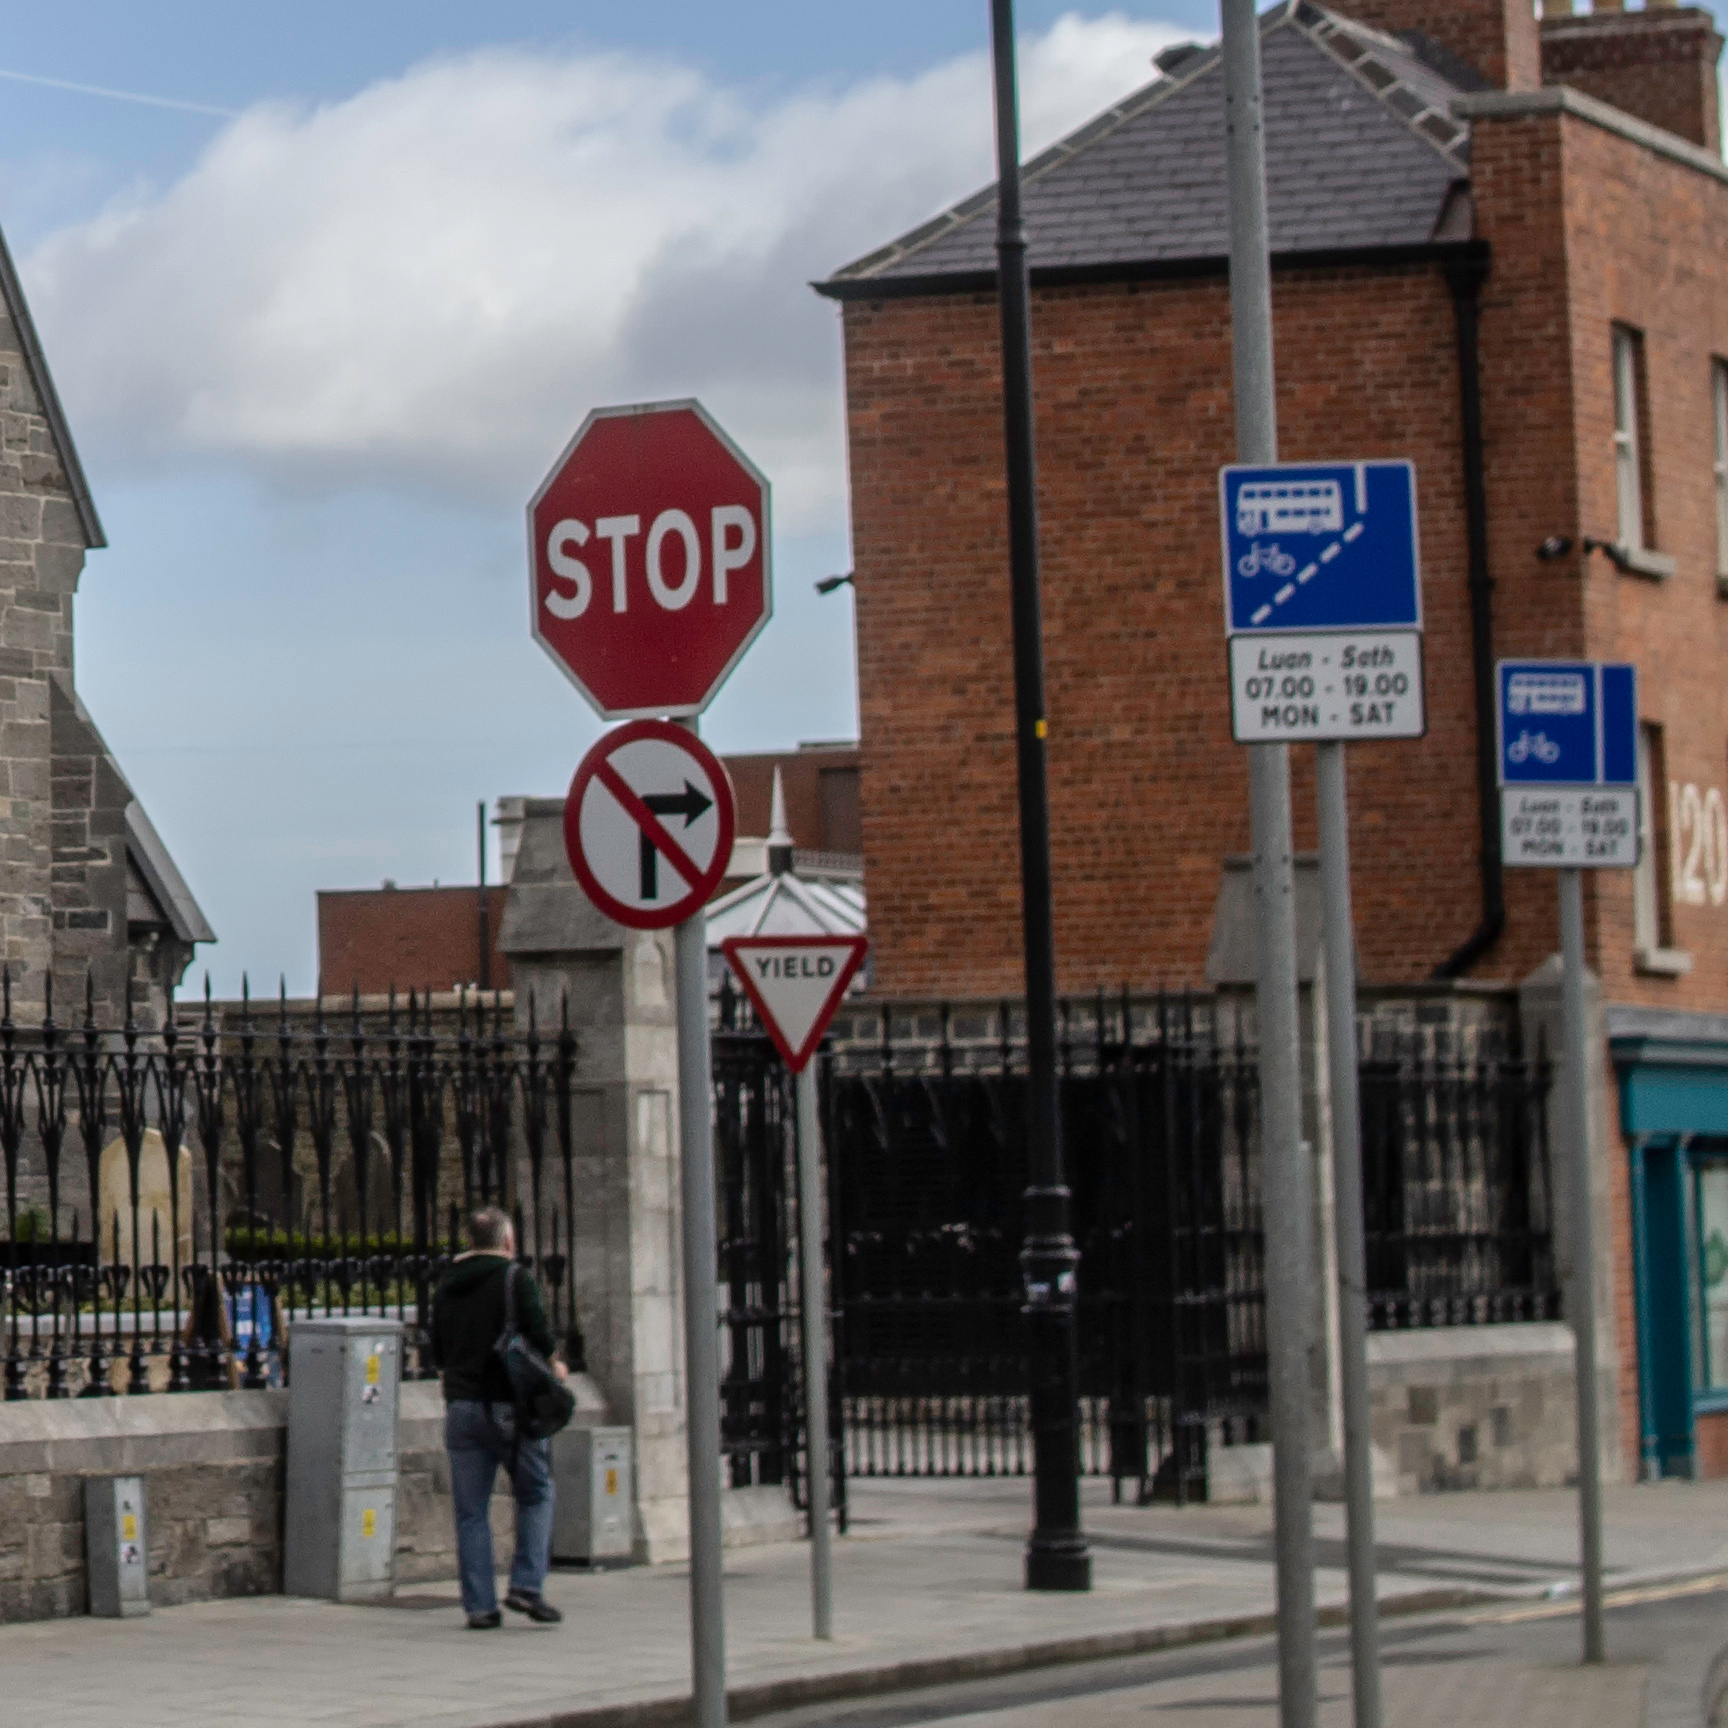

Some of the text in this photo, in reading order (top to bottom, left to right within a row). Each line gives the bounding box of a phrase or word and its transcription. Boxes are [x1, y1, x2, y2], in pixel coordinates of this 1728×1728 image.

[544, 503, 757, 621] STOP
[1257, 648, 1312, 671] Luan
[1341, 644, 1395, 669] Sath
[1245, 675, 1315, 700] 07.00
[1344, 673, 1409, 697] 19.00
[1260, 704, 1319, 728] MON
[1349, 701, 1395, 726] SAT
[754, 955, 835, 980] YIELD
